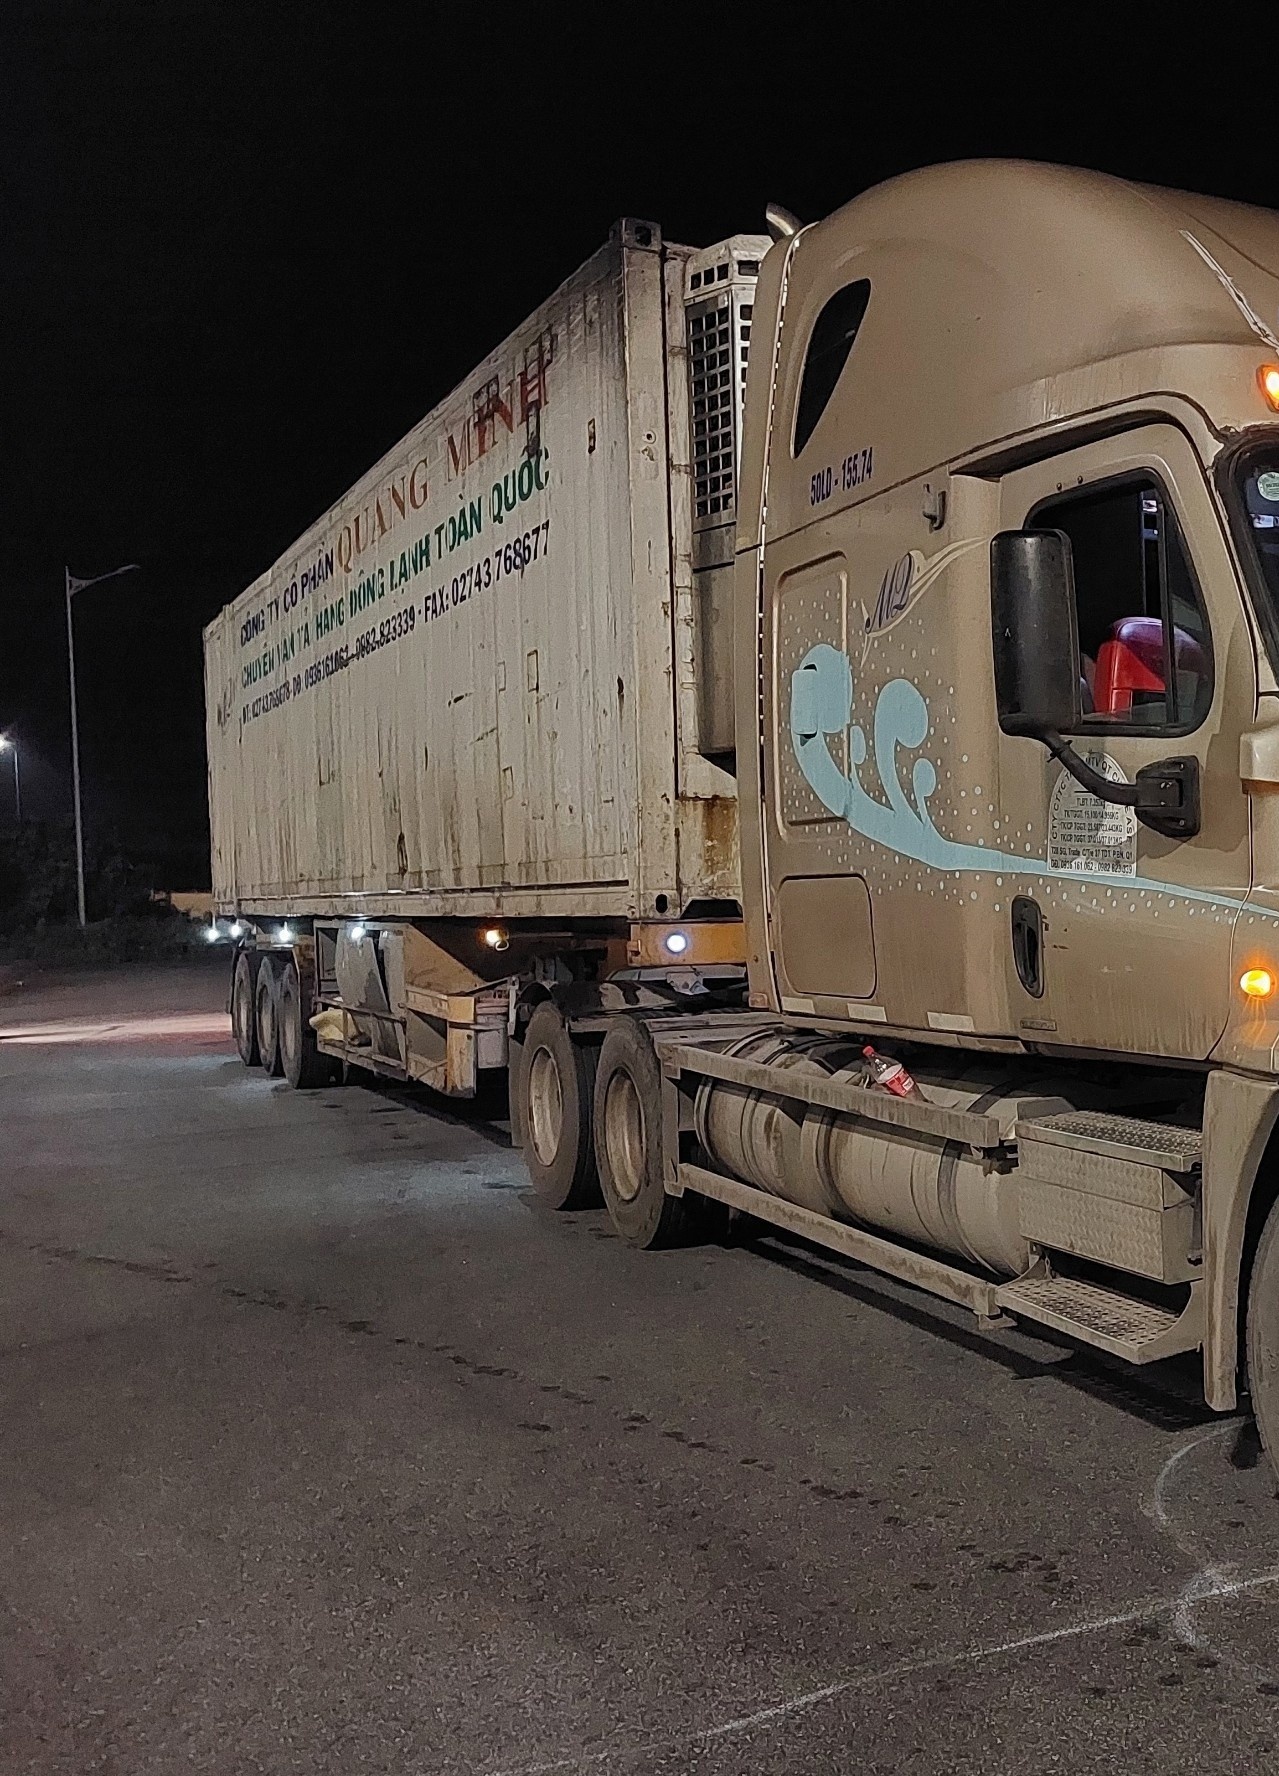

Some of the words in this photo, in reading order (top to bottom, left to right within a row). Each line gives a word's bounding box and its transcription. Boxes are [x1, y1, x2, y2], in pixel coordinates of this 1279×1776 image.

[267, 595, 280, 625] TY
[337, 457, 428, 574] QUANG
[444, 370, 549, 483] MINH
[810, 467, 831, 506] 50LD
[841, 447, 873, 491] 155.74
[434, 493, 482, 560] TOÀN
[424, 585, 449, 624] FAX:
